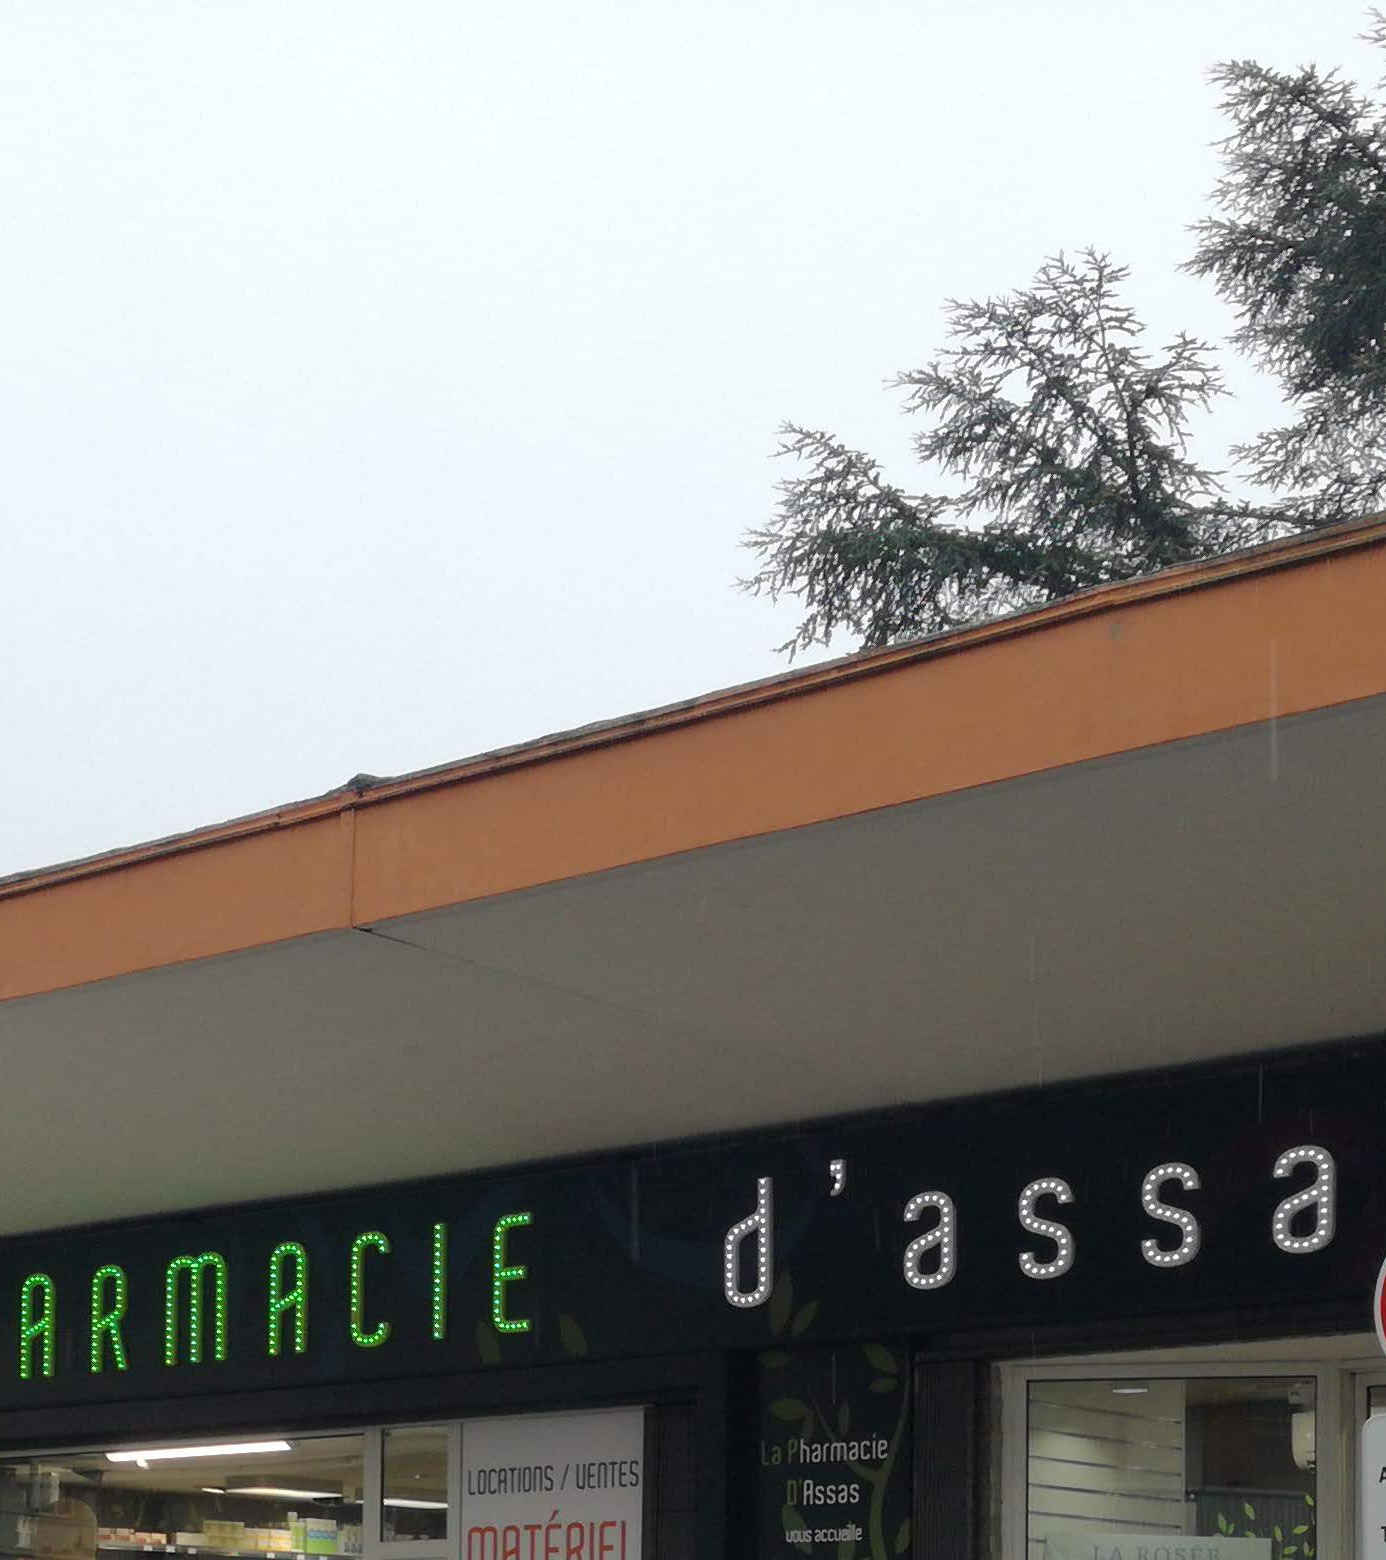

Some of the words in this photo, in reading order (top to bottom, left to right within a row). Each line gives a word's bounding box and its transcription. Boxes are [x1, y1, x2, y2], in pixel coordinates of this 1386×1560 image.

[761, 1440, 782, 1466] La
[788, 1432, 888, 1464] Pharmacie
[468, 1465, 554, 1495] LOCATIONS
[576, 1460, 639, 1490] VENTES
[787, 1479, 860, 1505] D'Assas
[786, 1528, 812, 1543] vous
[814, 1521, 863, 1543] accueille
